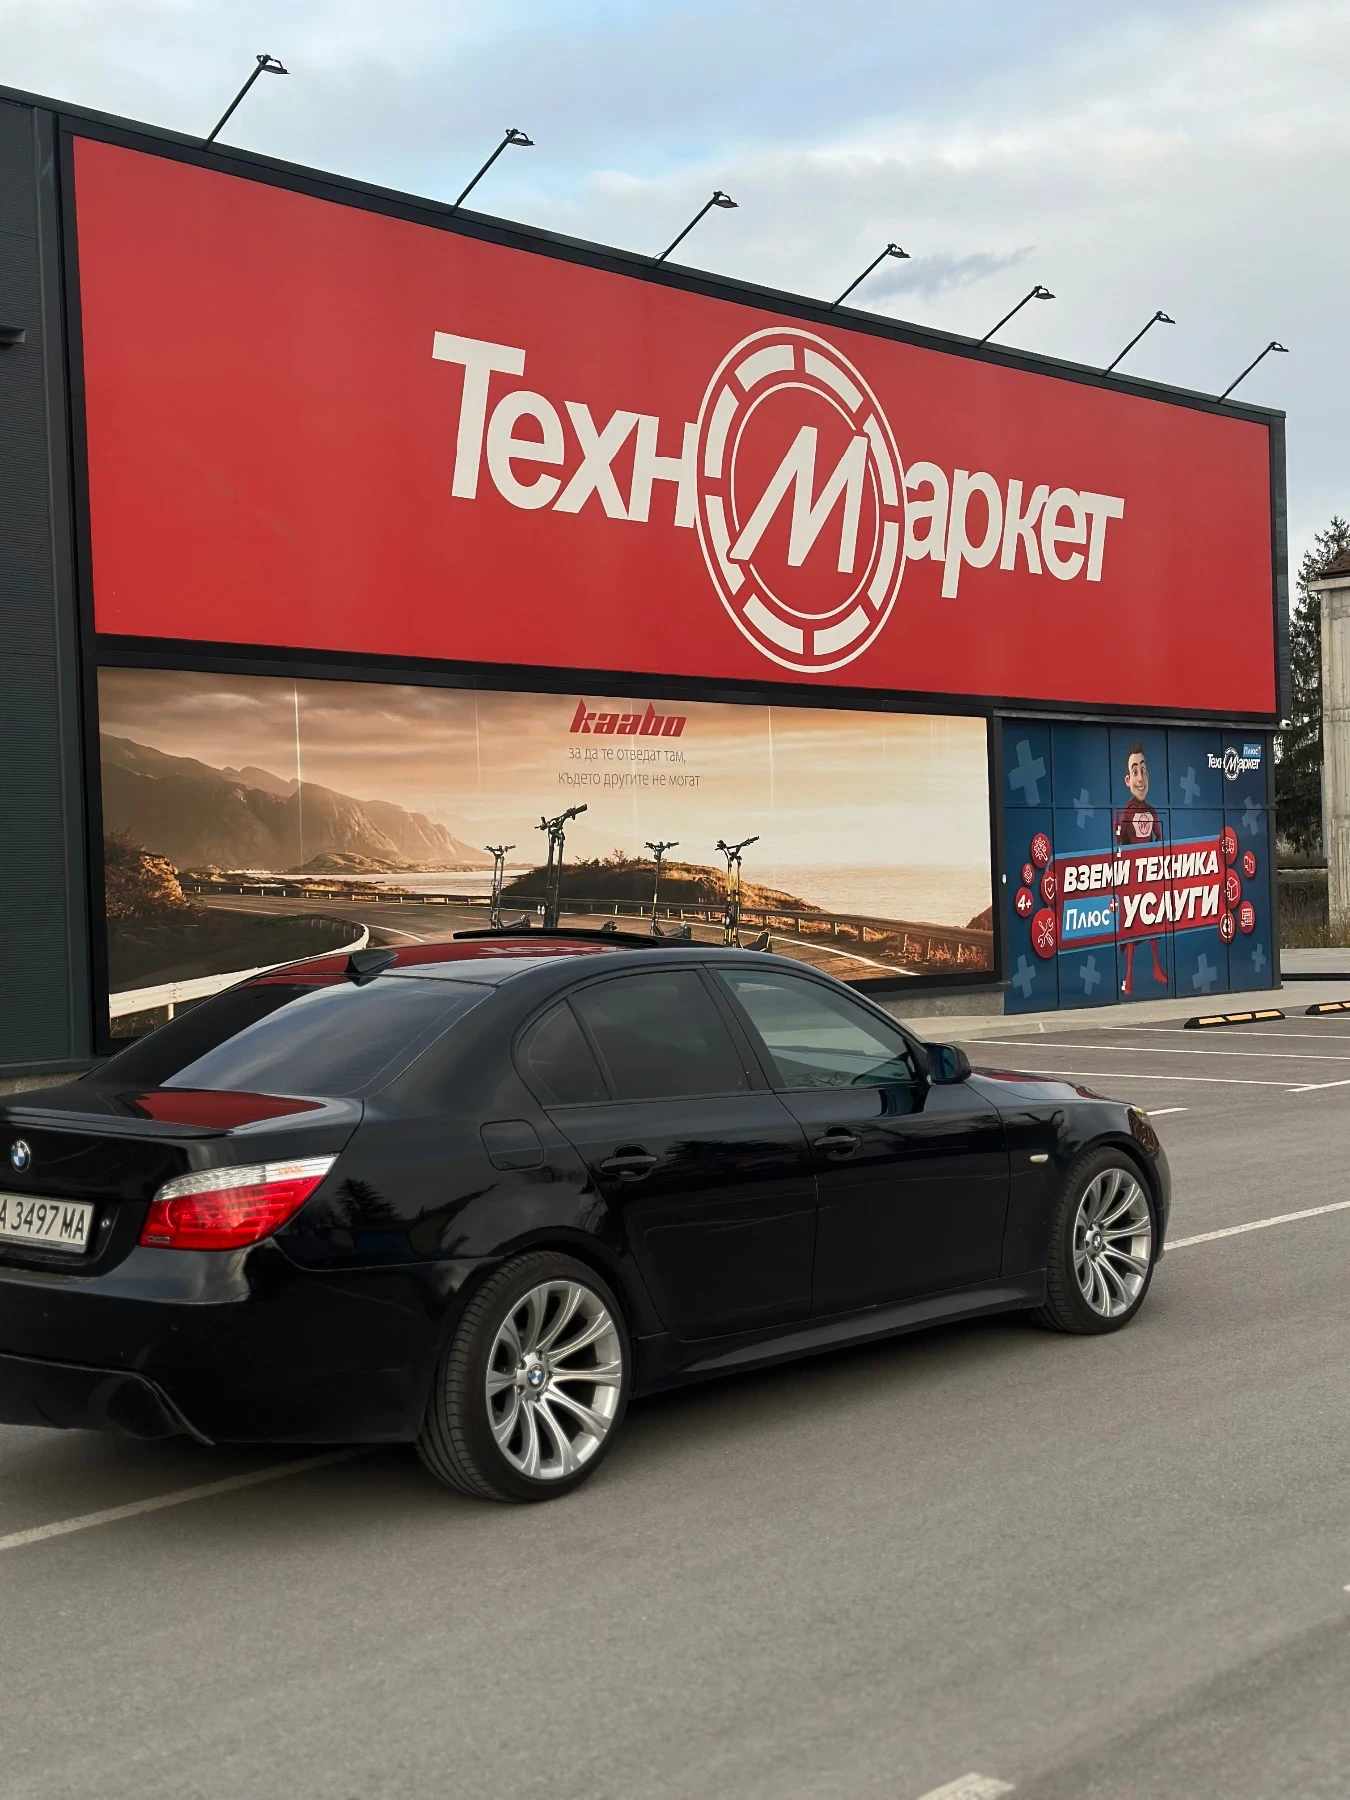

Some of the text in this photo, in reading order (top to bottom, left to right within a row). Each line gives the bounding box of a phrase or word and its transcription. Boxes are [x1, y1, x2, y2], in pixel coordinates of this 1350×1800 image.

[569, 698, 687, 737] kaabo
[568, 747, 687, 764] за да те отведат там,
[558, 772, 701, 789] където другите не могат
[1063, 850, 1219, 893] ВЗЕМИ ТЕХНИКА
[1123, 884, 1220, 928] УСЛУГИ
